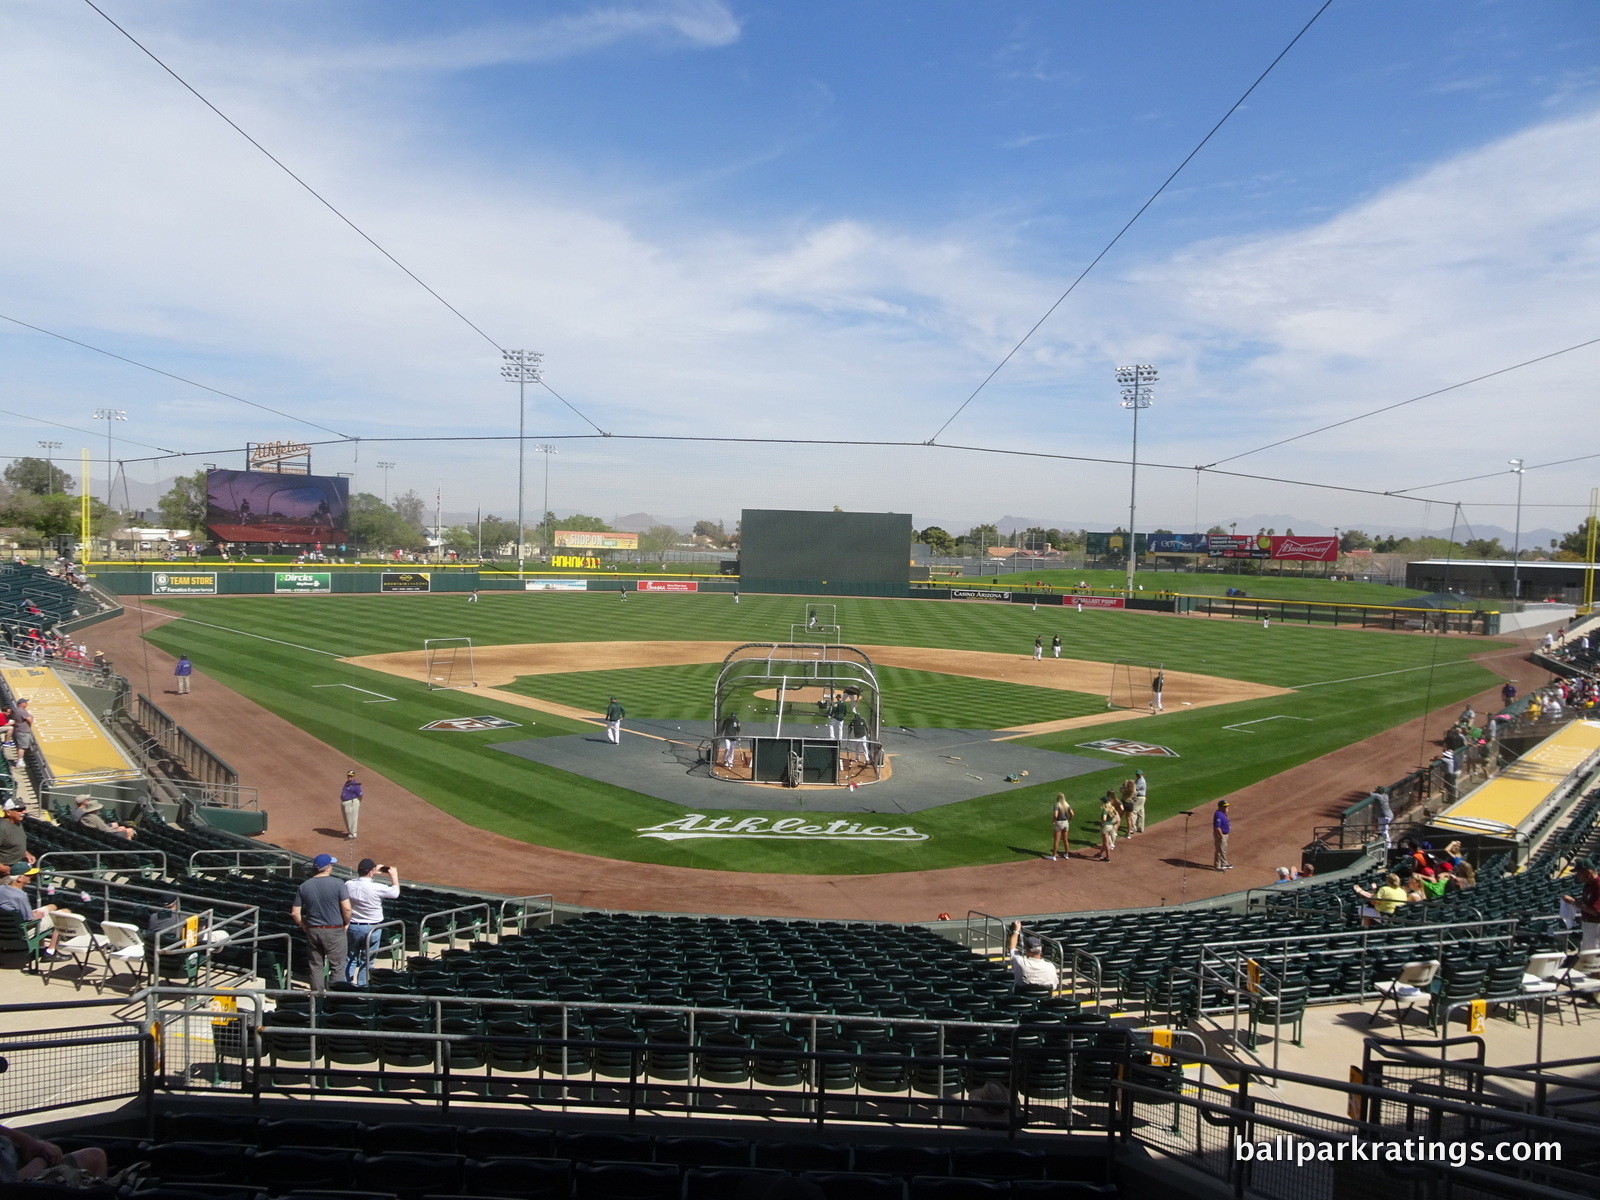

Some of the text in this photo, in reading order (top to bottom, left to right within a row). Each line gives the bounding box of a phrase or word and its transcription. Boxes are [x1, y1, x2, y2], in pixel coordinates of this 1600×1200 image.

[251, 440, 310, 461] Athletics
[570, 533, 602, 547] SHOP ON
[1282, 543, 1327, 553] Budweiser
[170, 576, 214, 585] TEAM STORE
[636, 814, 928, 838] Athletics
